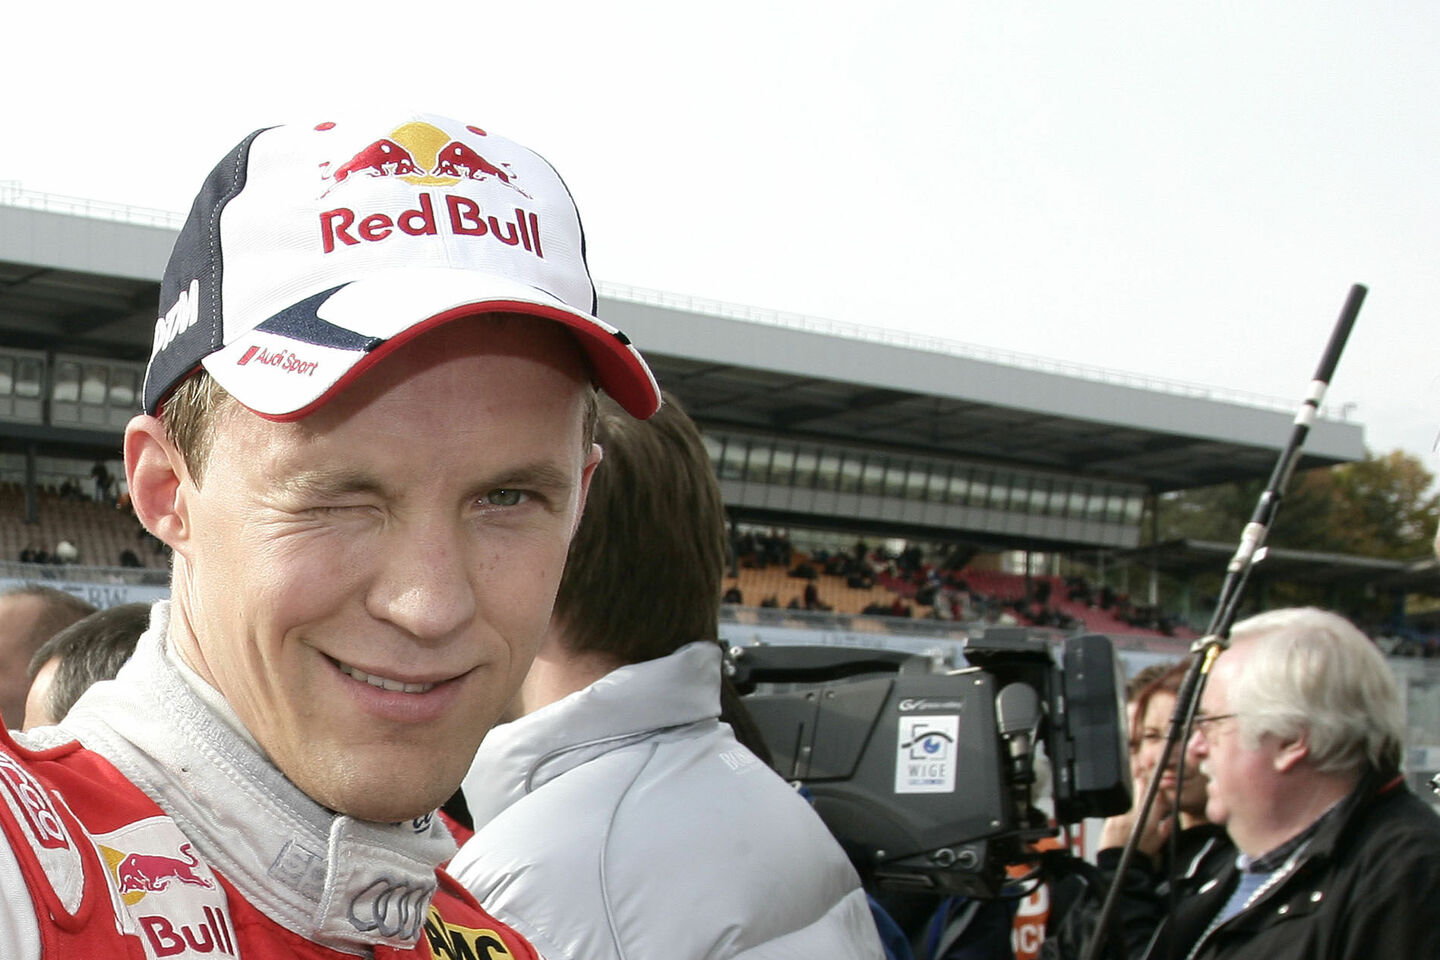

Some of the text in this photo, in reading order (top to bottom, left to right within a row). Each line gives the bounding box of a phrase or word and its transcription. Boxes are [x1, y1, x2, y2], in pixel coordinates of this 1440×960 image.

[320, 192, 545, 259] Red Bull
[256, 350, 320, 377] Audi Sport
[908, 763, 946, 778] WIGE
[138, 905, 235, 958] Bull
